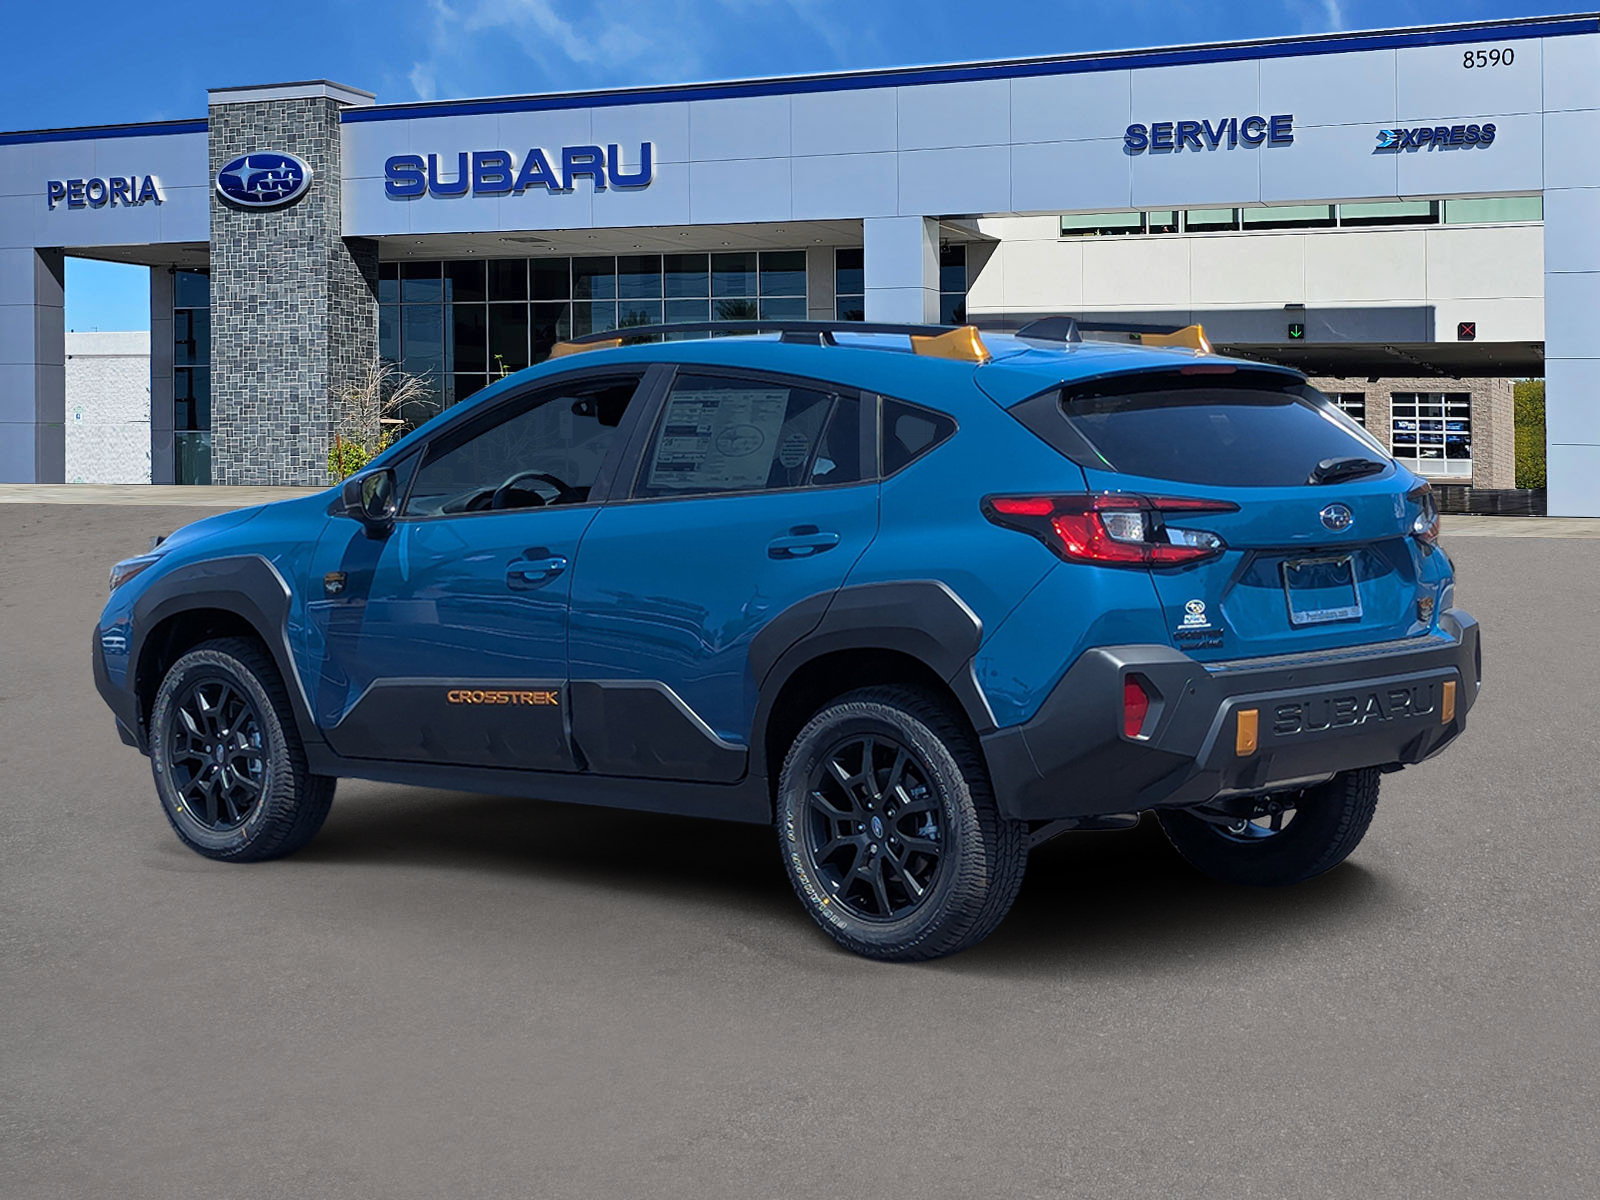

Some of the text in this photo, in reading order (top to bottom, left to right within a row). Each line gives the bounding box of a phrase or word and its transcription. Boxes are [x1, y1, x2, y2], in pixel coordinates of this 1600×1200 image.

[1463, 48, 1514, 69] 8590
[1124, 114, 1294, 151] SERVICE
[1374, 123, 1497, 150] EXPRESS
[384, 142, 652, 197] SUBARU
[47, 174, 161, 208] PEORIA
[446, 689, 559, 706] CROSSTREK
[1272, 683, 1435, 737] SUBARU
